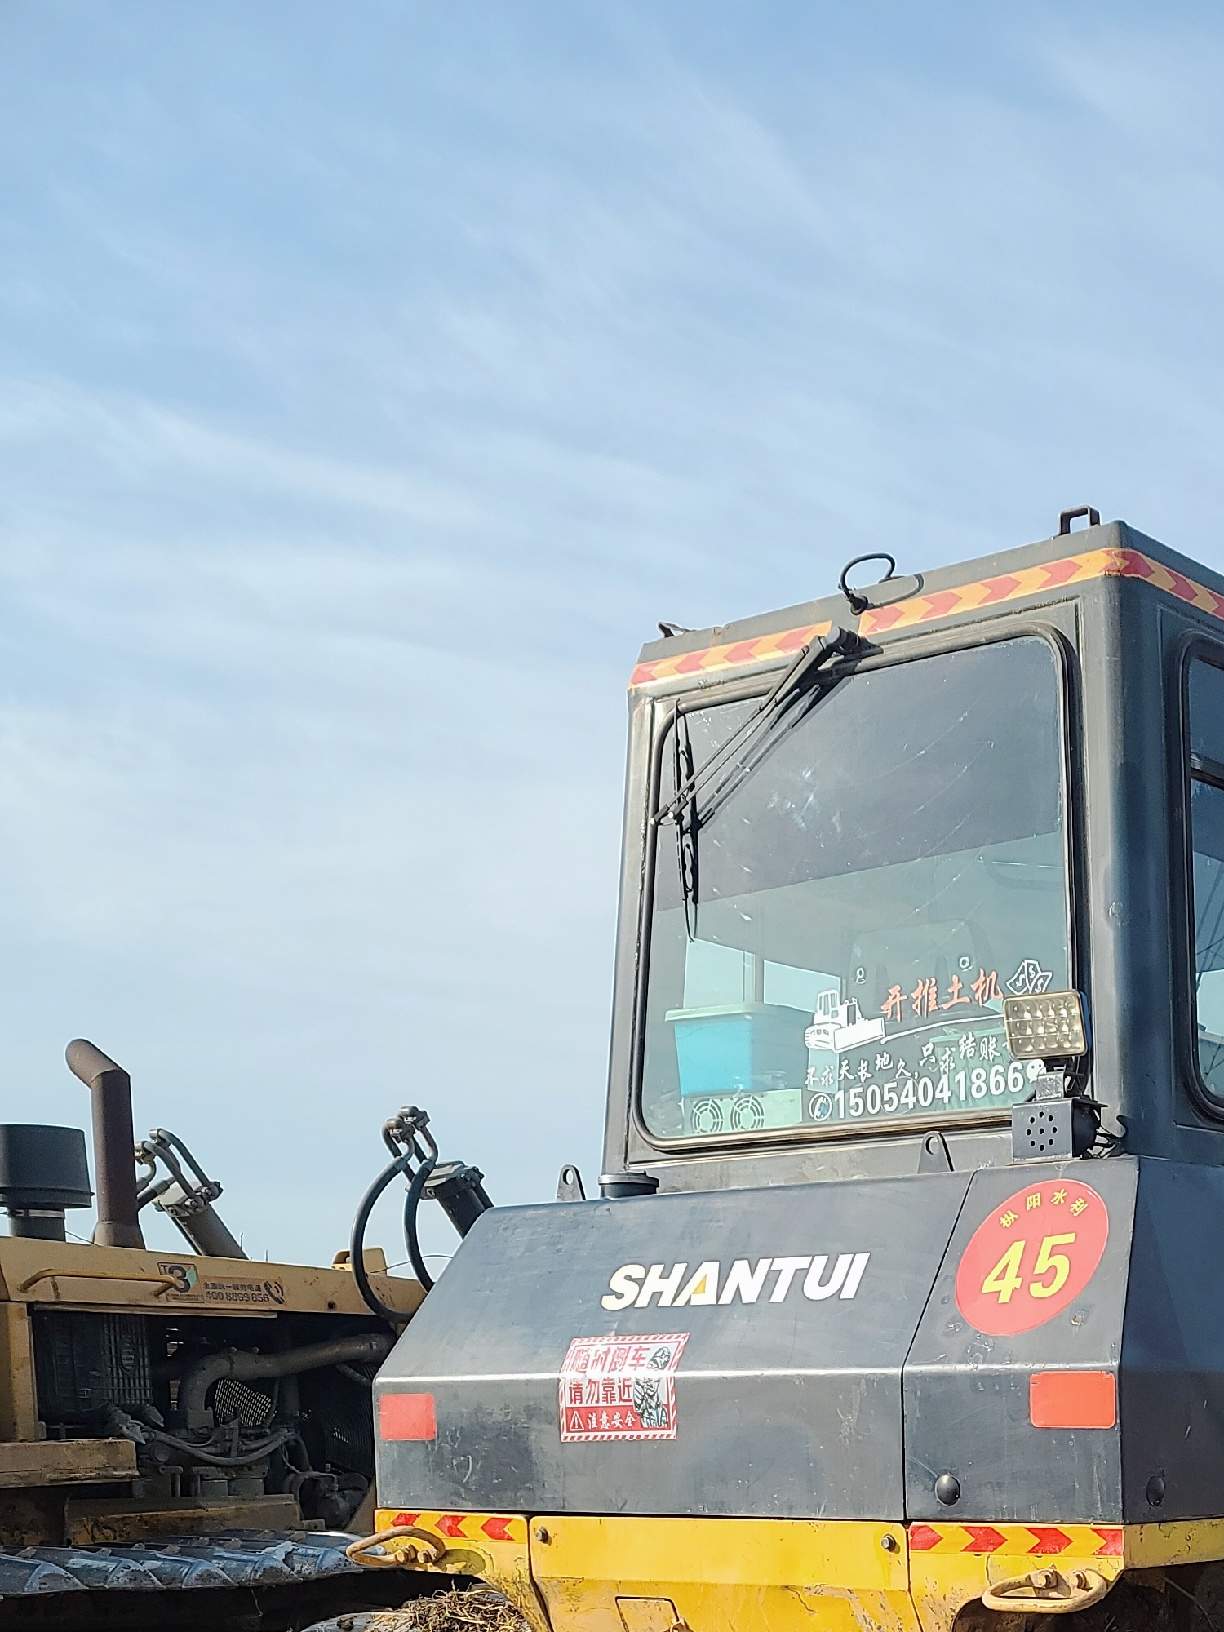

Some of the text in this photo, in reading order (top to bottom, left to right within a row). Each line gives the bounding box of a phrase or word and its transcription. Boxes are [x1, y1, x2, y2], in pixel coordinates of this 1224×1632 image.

[880, 968, 1004, 1022] 开推土机
[834, 1061, 1025, 1119] 15054041866
[600, 1252, 872, 1312] SHANTUI
[981, 1232, 1077, 1305] 45
[569, 1376, 633, 1405] 请勿靠近
[587, 1410, 637, 1430] 注意安全
